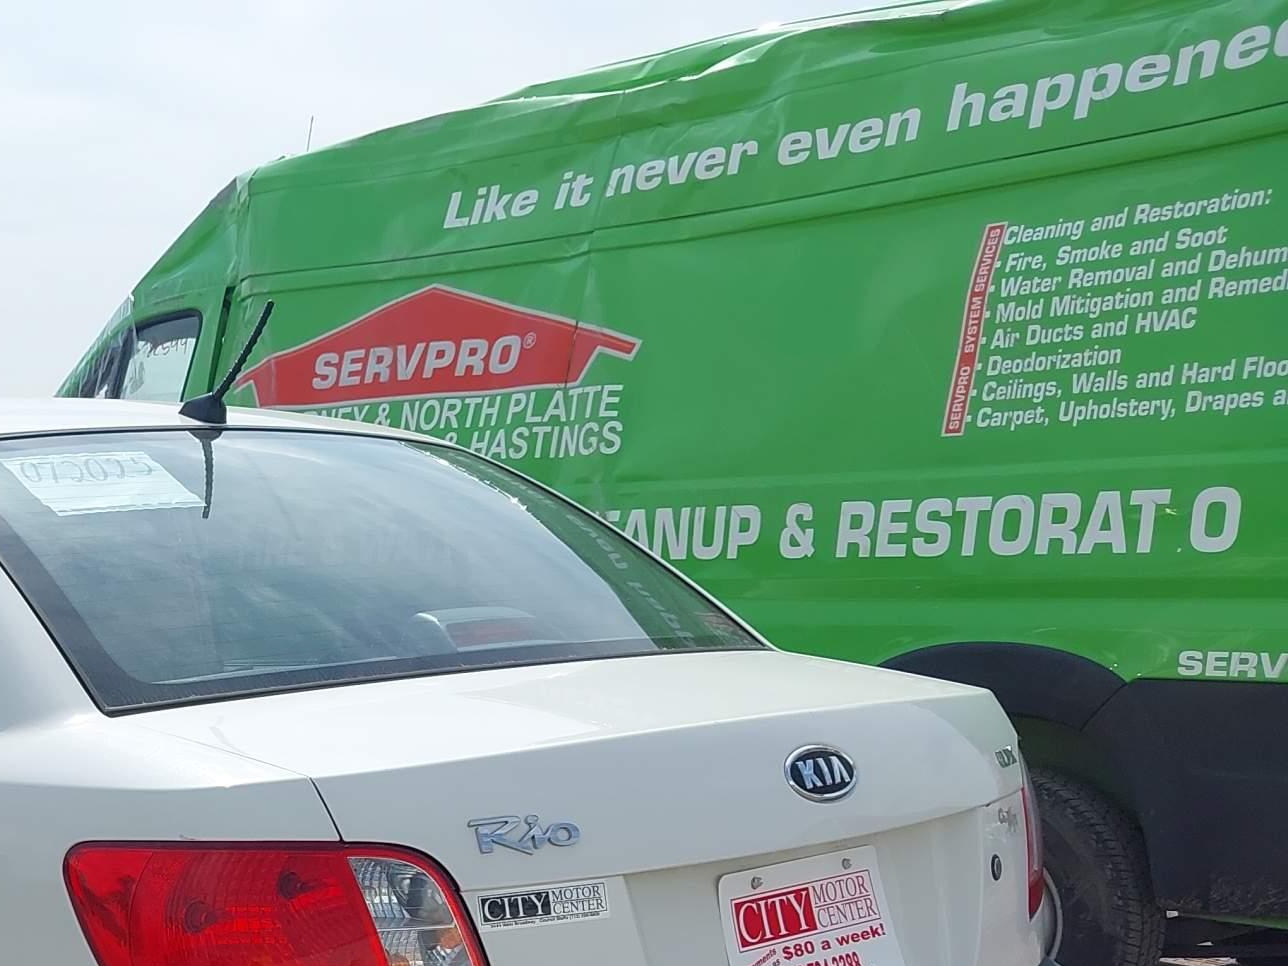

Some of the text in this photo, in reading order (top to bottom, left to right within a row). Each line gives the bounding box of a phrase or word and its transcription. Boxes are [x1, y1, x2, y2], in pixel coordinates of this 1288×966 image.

[443, 184, 539, 228] Like
[553, 171, 594, 210] it
[605, 140, 759, 197] never
[777, 106, 921, 166] even
[1003, 188, 1273, 245] Cleaning and Restoration:
[1005, 225, 1229, 273] Fire, Smoke and Soot
[964, 294, 983, 353] SYSTEM
[974, 228, 1001, 292] SERVICES
[995, 268, 1288, 323] Mold Mitigation and Remed
[1000, 275, 1062, 298] Water
[1068, 258, 1155, 289] Removal
[1161, 252, 1202, 278] and
[990, 306, 1198, 350] Air Ducts and HVAC
[982, 378, 1062, 403] Ceilings,
[1072, 370, 1129, 394] Walls
[1136, 364, 1175, 389] and
[1181, 358, 1237, 385] Hard
[987, 345, 1122, 376] Deodorization
[400, 396, 501, 431] NORTH
[515, 384, 624, 423] PLATTE
[976, 406, 1050, 431] Carpet,
[1058, 397, 1176, 427] Upholstery,
[1185, 390, 1264, 416] Drapes
[469, 421, 624, 460] HASTINGS
[779, 502, 815, 559] &
[795, 755, 851, 789] KIA
[467, 814, 581, 856] Rio
[484, 893, 548, 921] CITY
[552, 885, 601, 902] MOTOR
[552, 898, 605, 915] CENTER
[738, 875, 869, 943] CITY MOTOR
[817, 897, 878, 928] CENTER
[782, 923, 886, 961] $80 a week!
